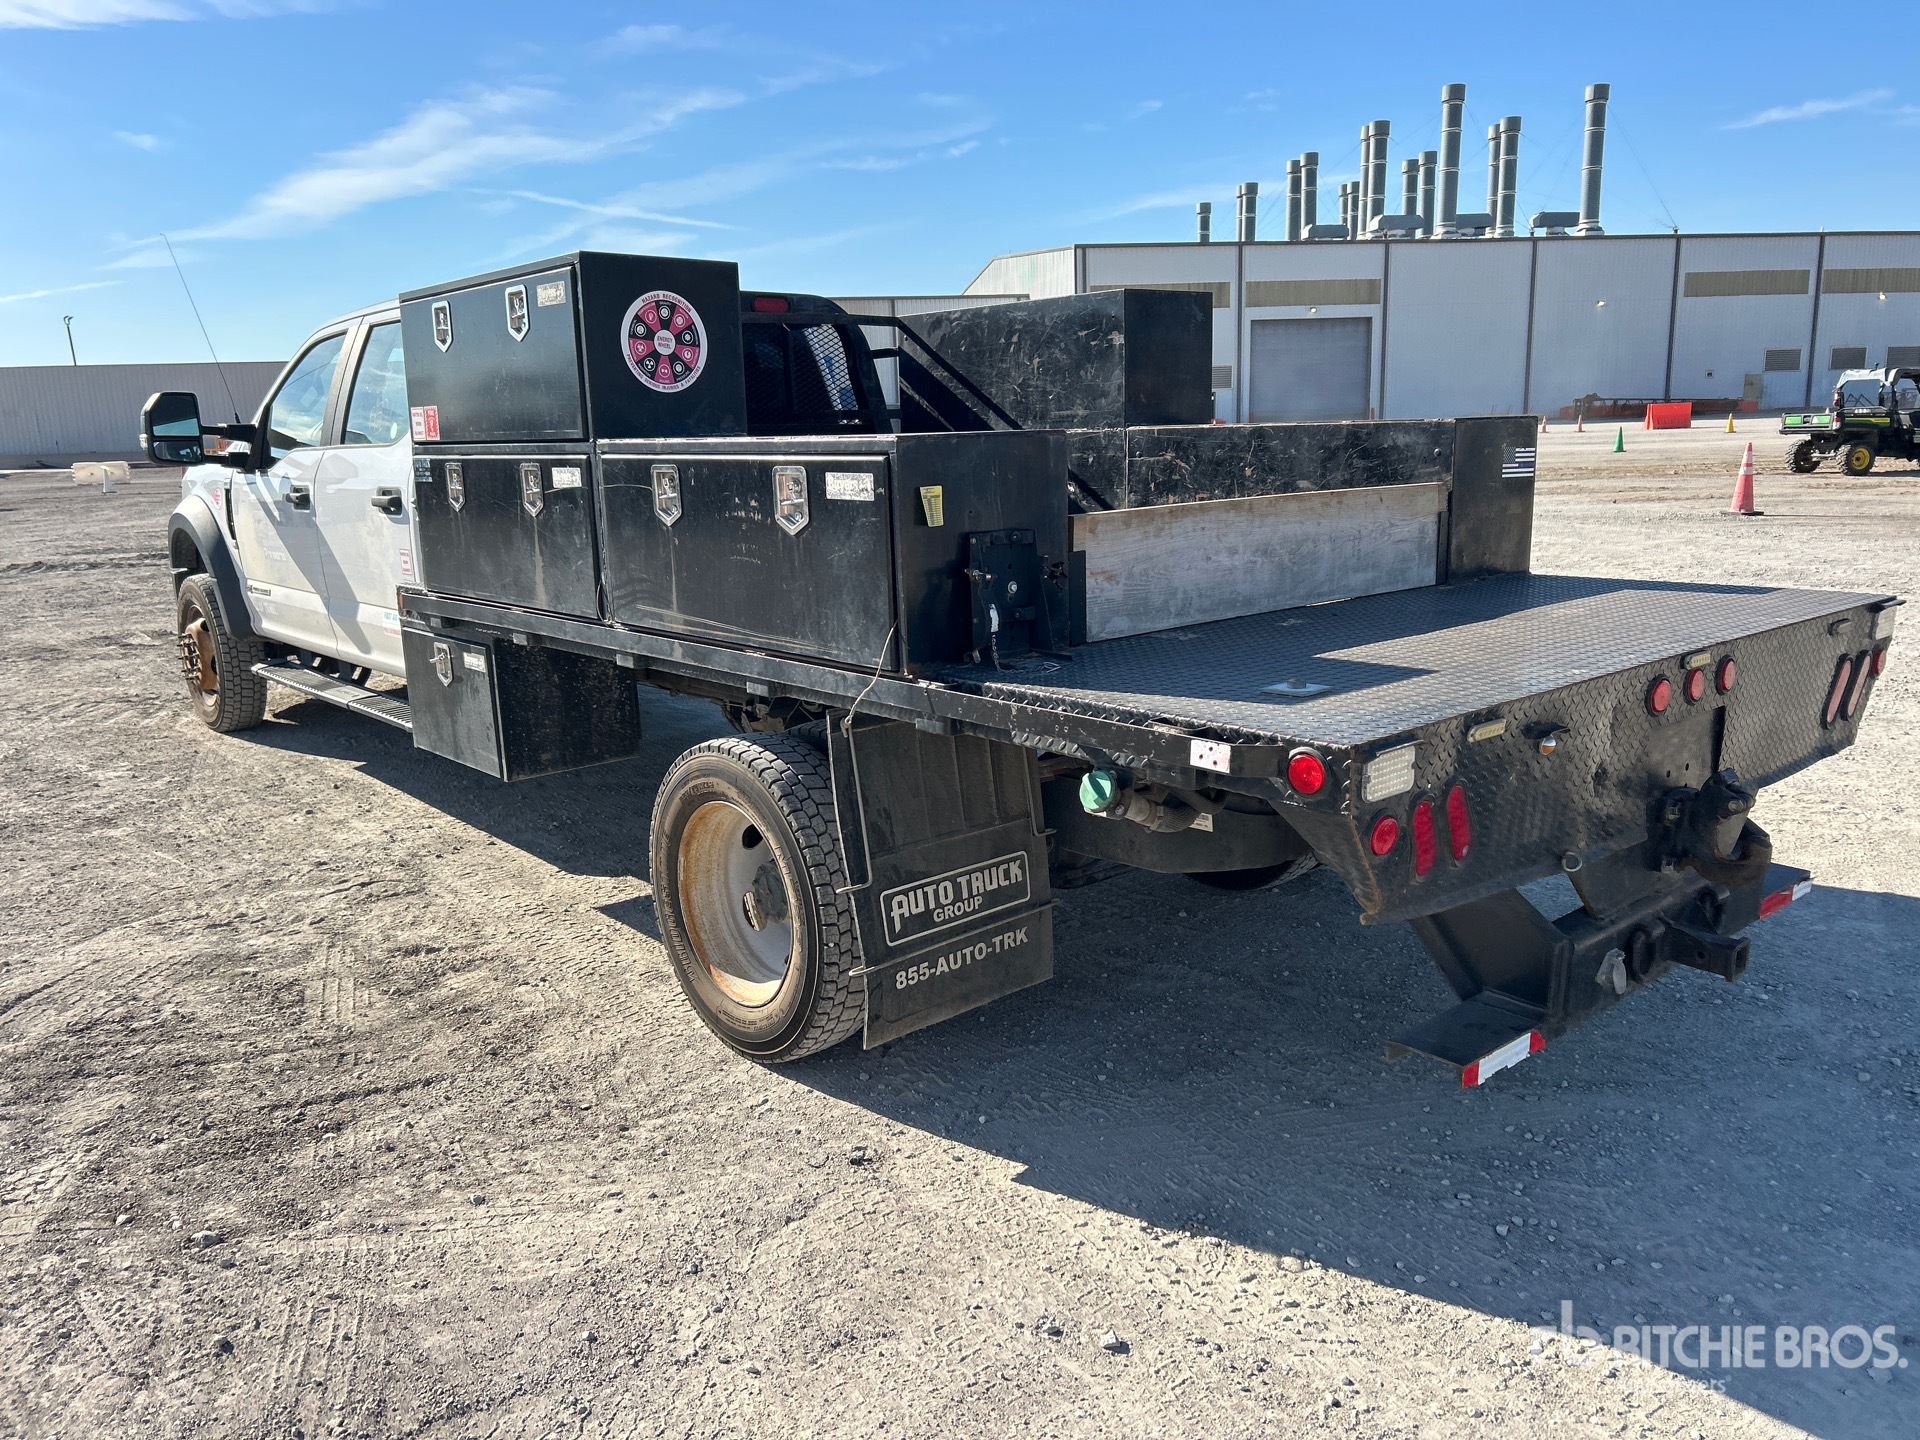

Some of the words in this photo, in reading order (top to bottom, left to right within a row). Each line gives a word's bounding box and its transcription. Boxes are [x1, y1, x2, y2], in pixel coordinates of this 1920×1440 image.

[641, 293, 660, 304] HAZARD
[662, 293, 692, 313] RECOGNITION
[657, 335, 673, 343] ENERGY
[626, 353, 644, 379] PREVENTING
[644, 377, 660, 389] SERIOUS
[685, 366, 701, 385] FATALITIES
[891, 880, 954, 934] AUTO
[957, 859, 1023, 900] TRUCK
[933, 895, 983, 923] GROUP
[895, 927, 1029, 990] 855-AUTO-TRK
